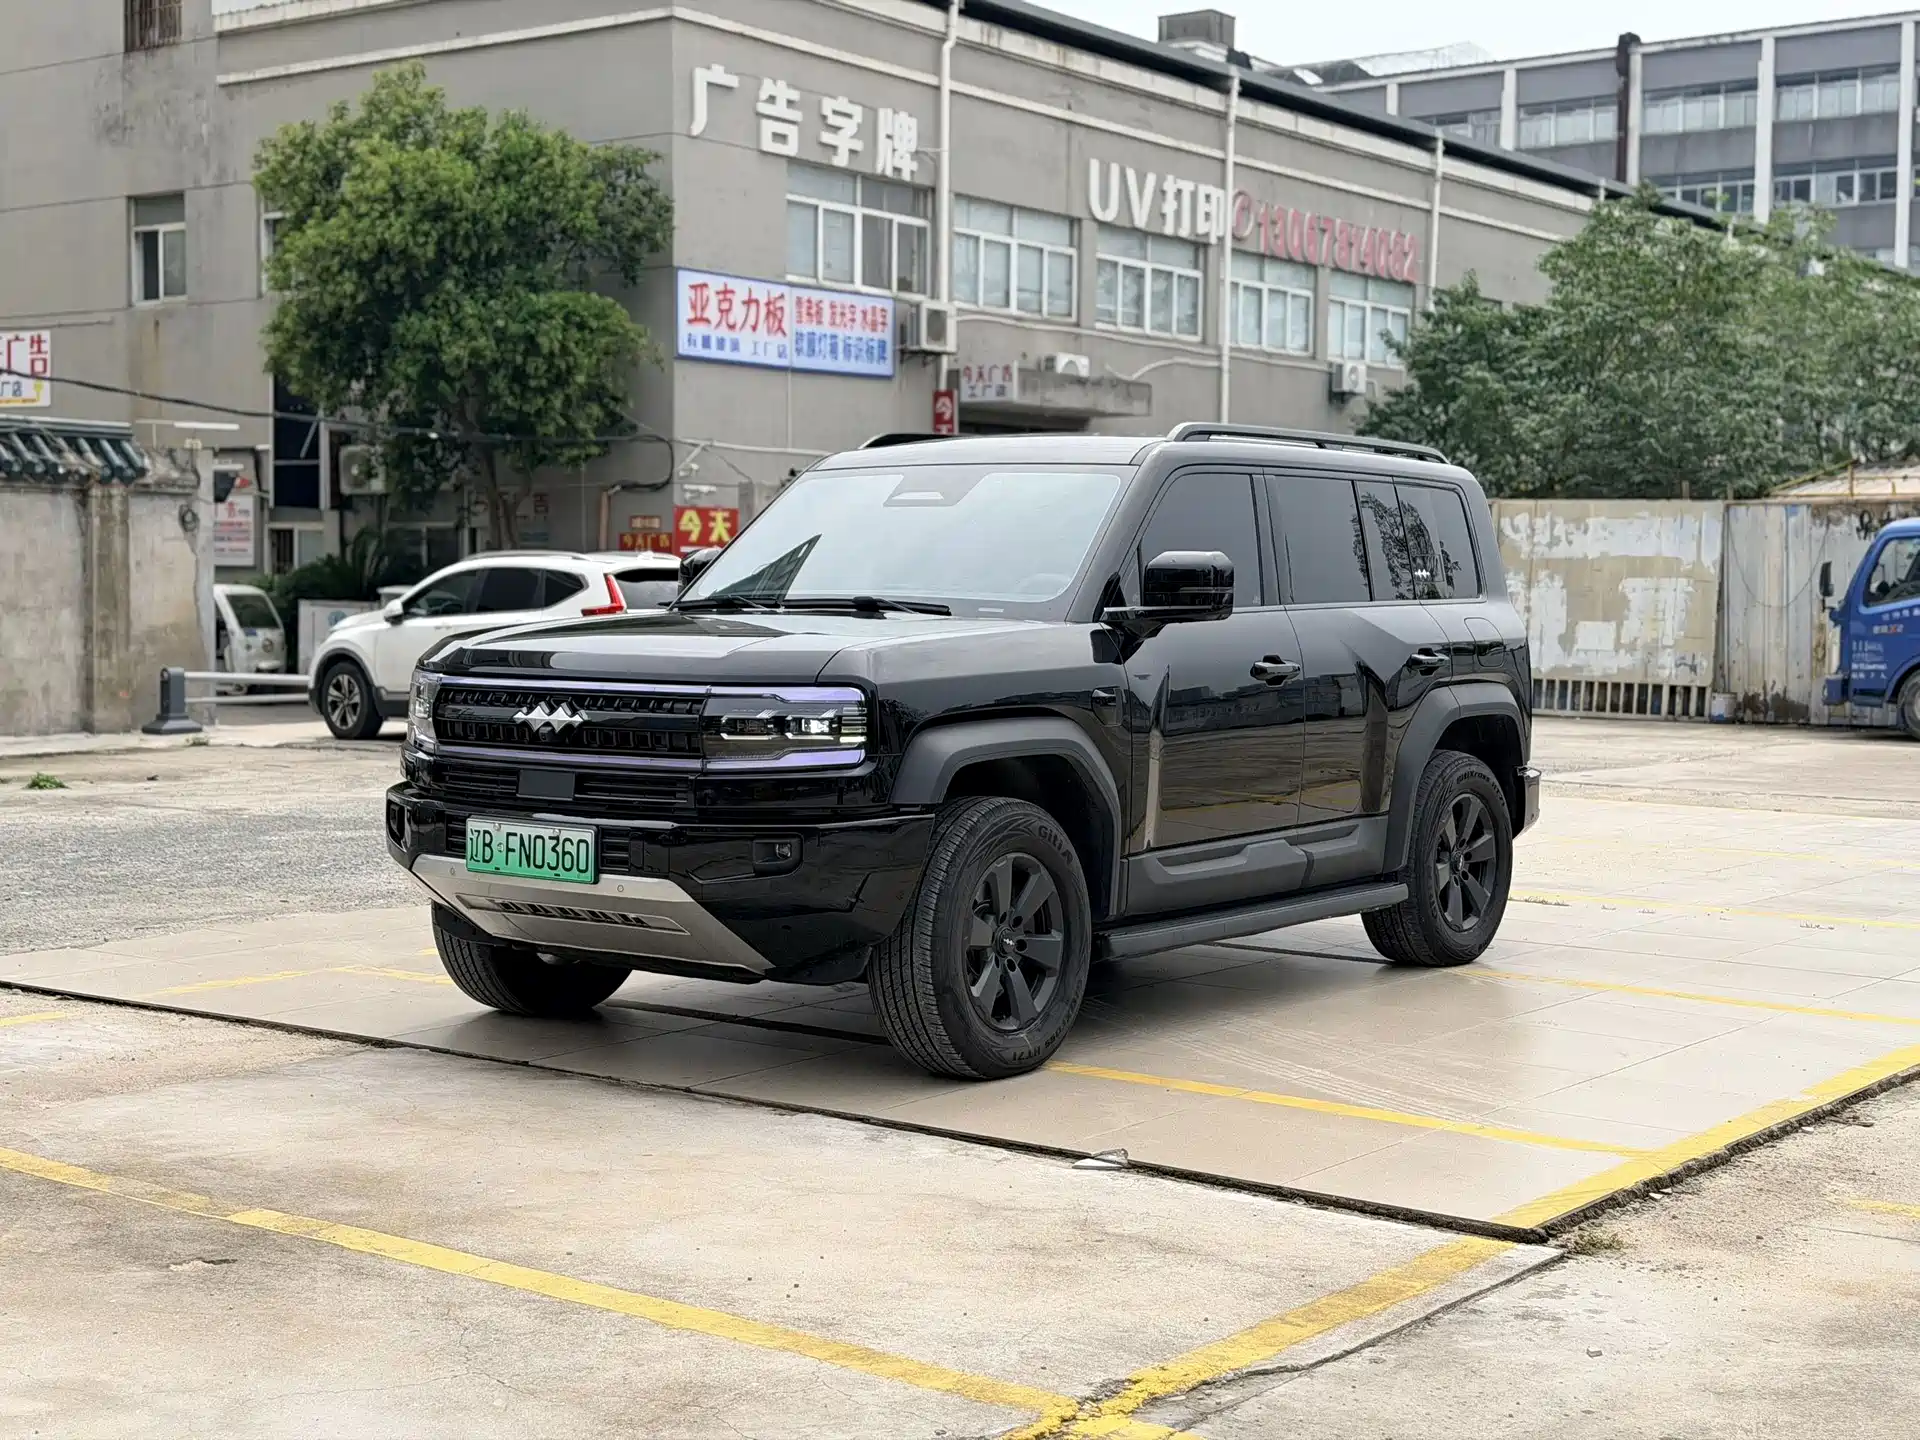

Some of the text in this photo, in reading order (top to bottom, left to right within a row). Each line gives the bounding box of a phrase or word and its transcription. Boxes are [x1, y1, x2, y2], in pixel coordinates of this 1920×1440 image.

[690, 63, 918, 181] 广告字牌
[686, 282, 788, 338] 亚克力板
[0, 333, 48, 377] 广告
[679, 508, 733, 543] 今天
